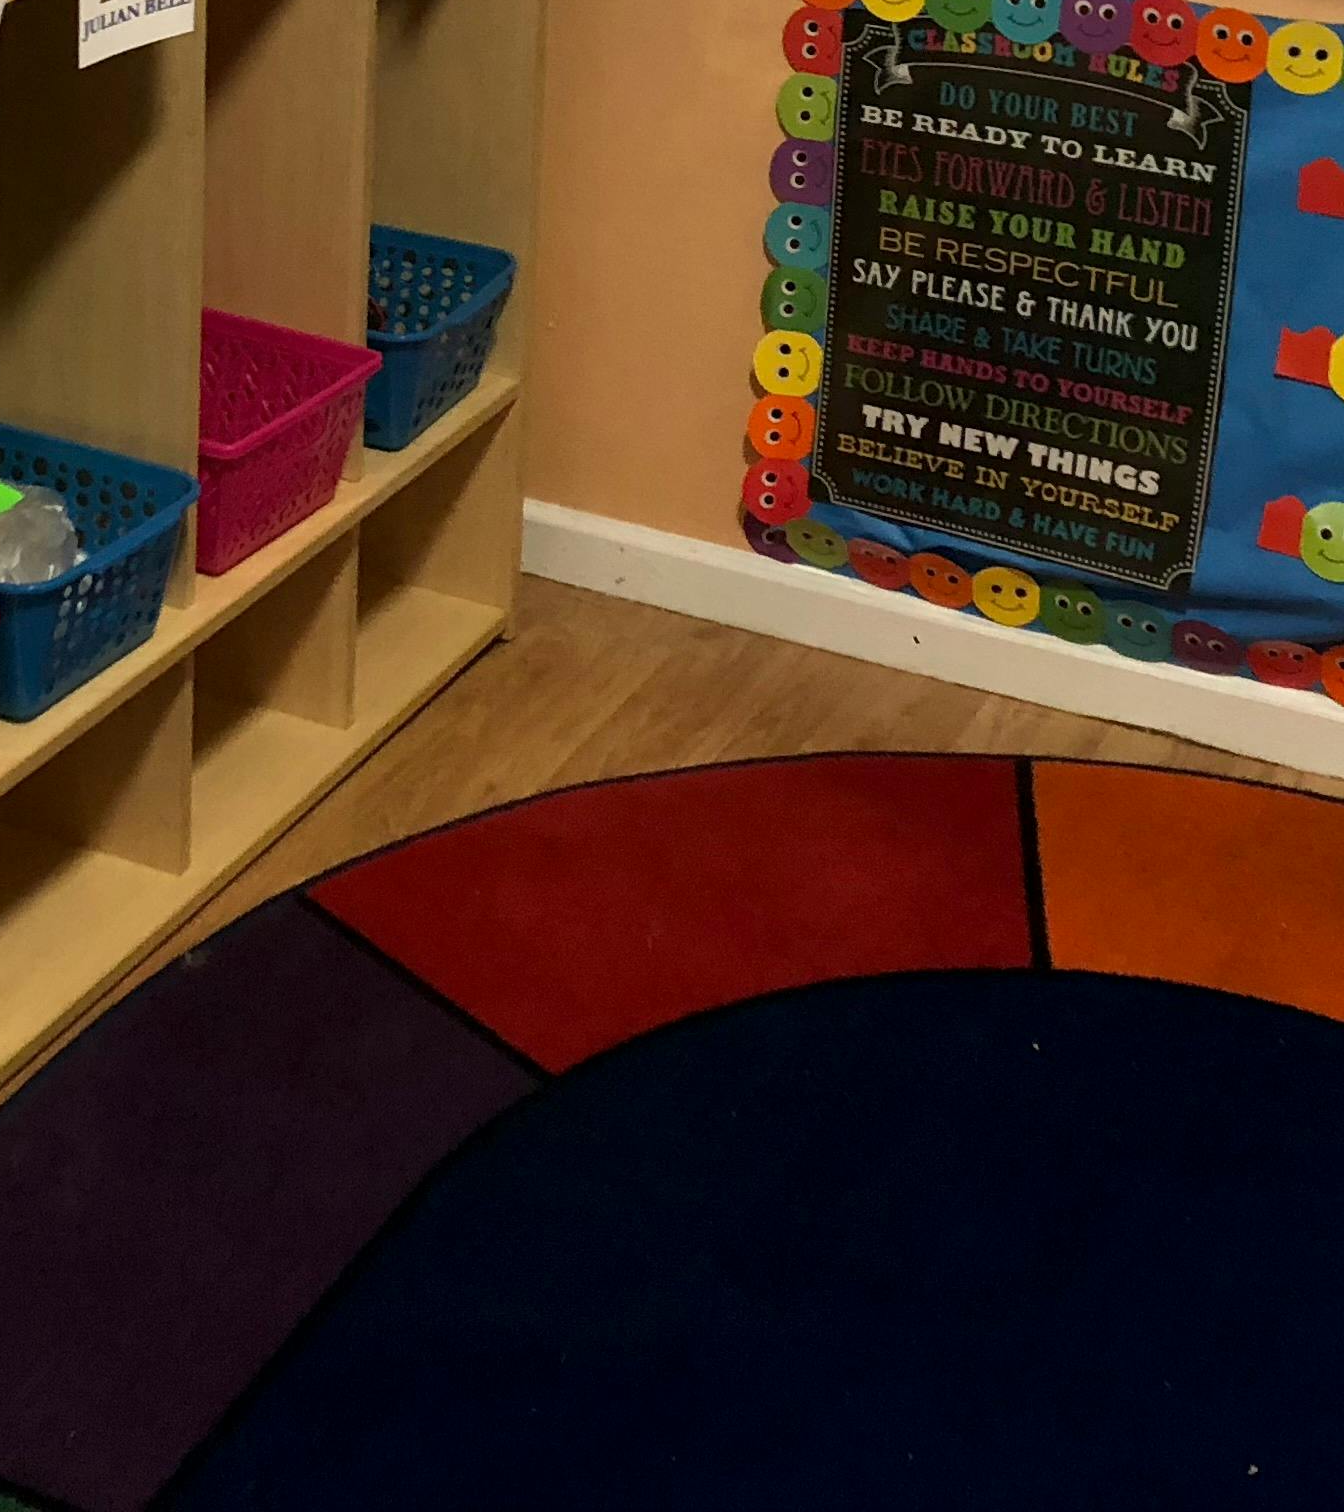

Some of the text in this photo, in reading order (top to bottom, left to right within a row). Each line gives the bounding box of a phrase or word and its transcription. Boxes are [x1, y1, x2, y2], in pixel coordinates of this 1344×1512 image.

[82, 2, 141, 41] JULIAN
[908, 28, 1180, 92] CLASSROOM RULES
[860, 105, 1218, 184] BE READY TO LEARN
[940, 81, 1139, 138] DO YOUR BEST
[860, 139, 1213, 237] EYES FORWARD & LISTEN
[878, 189, 1187, 269] RAISE YOUR HAND
[853, 258, 1199, 352] SAY PLEASE & THANK YOU
[879, 226, 1179, 309] BE RESPECTFUL
[847, 333, 1194, 426] KEEP HANDS TO YOURSELF
[885, 305, 1157, 385] SHARE & TAKE TURNS
[844, 365, 1190, 465] FOLLOW DIRECTIONS
[862, 405, 1161, 495] TRY NEW THINGS
[837, 433, 1180, 533] BELIEVE IN YOURSELF
[852, 469, 1155, 562] WORK HARD & HAVE FUN
